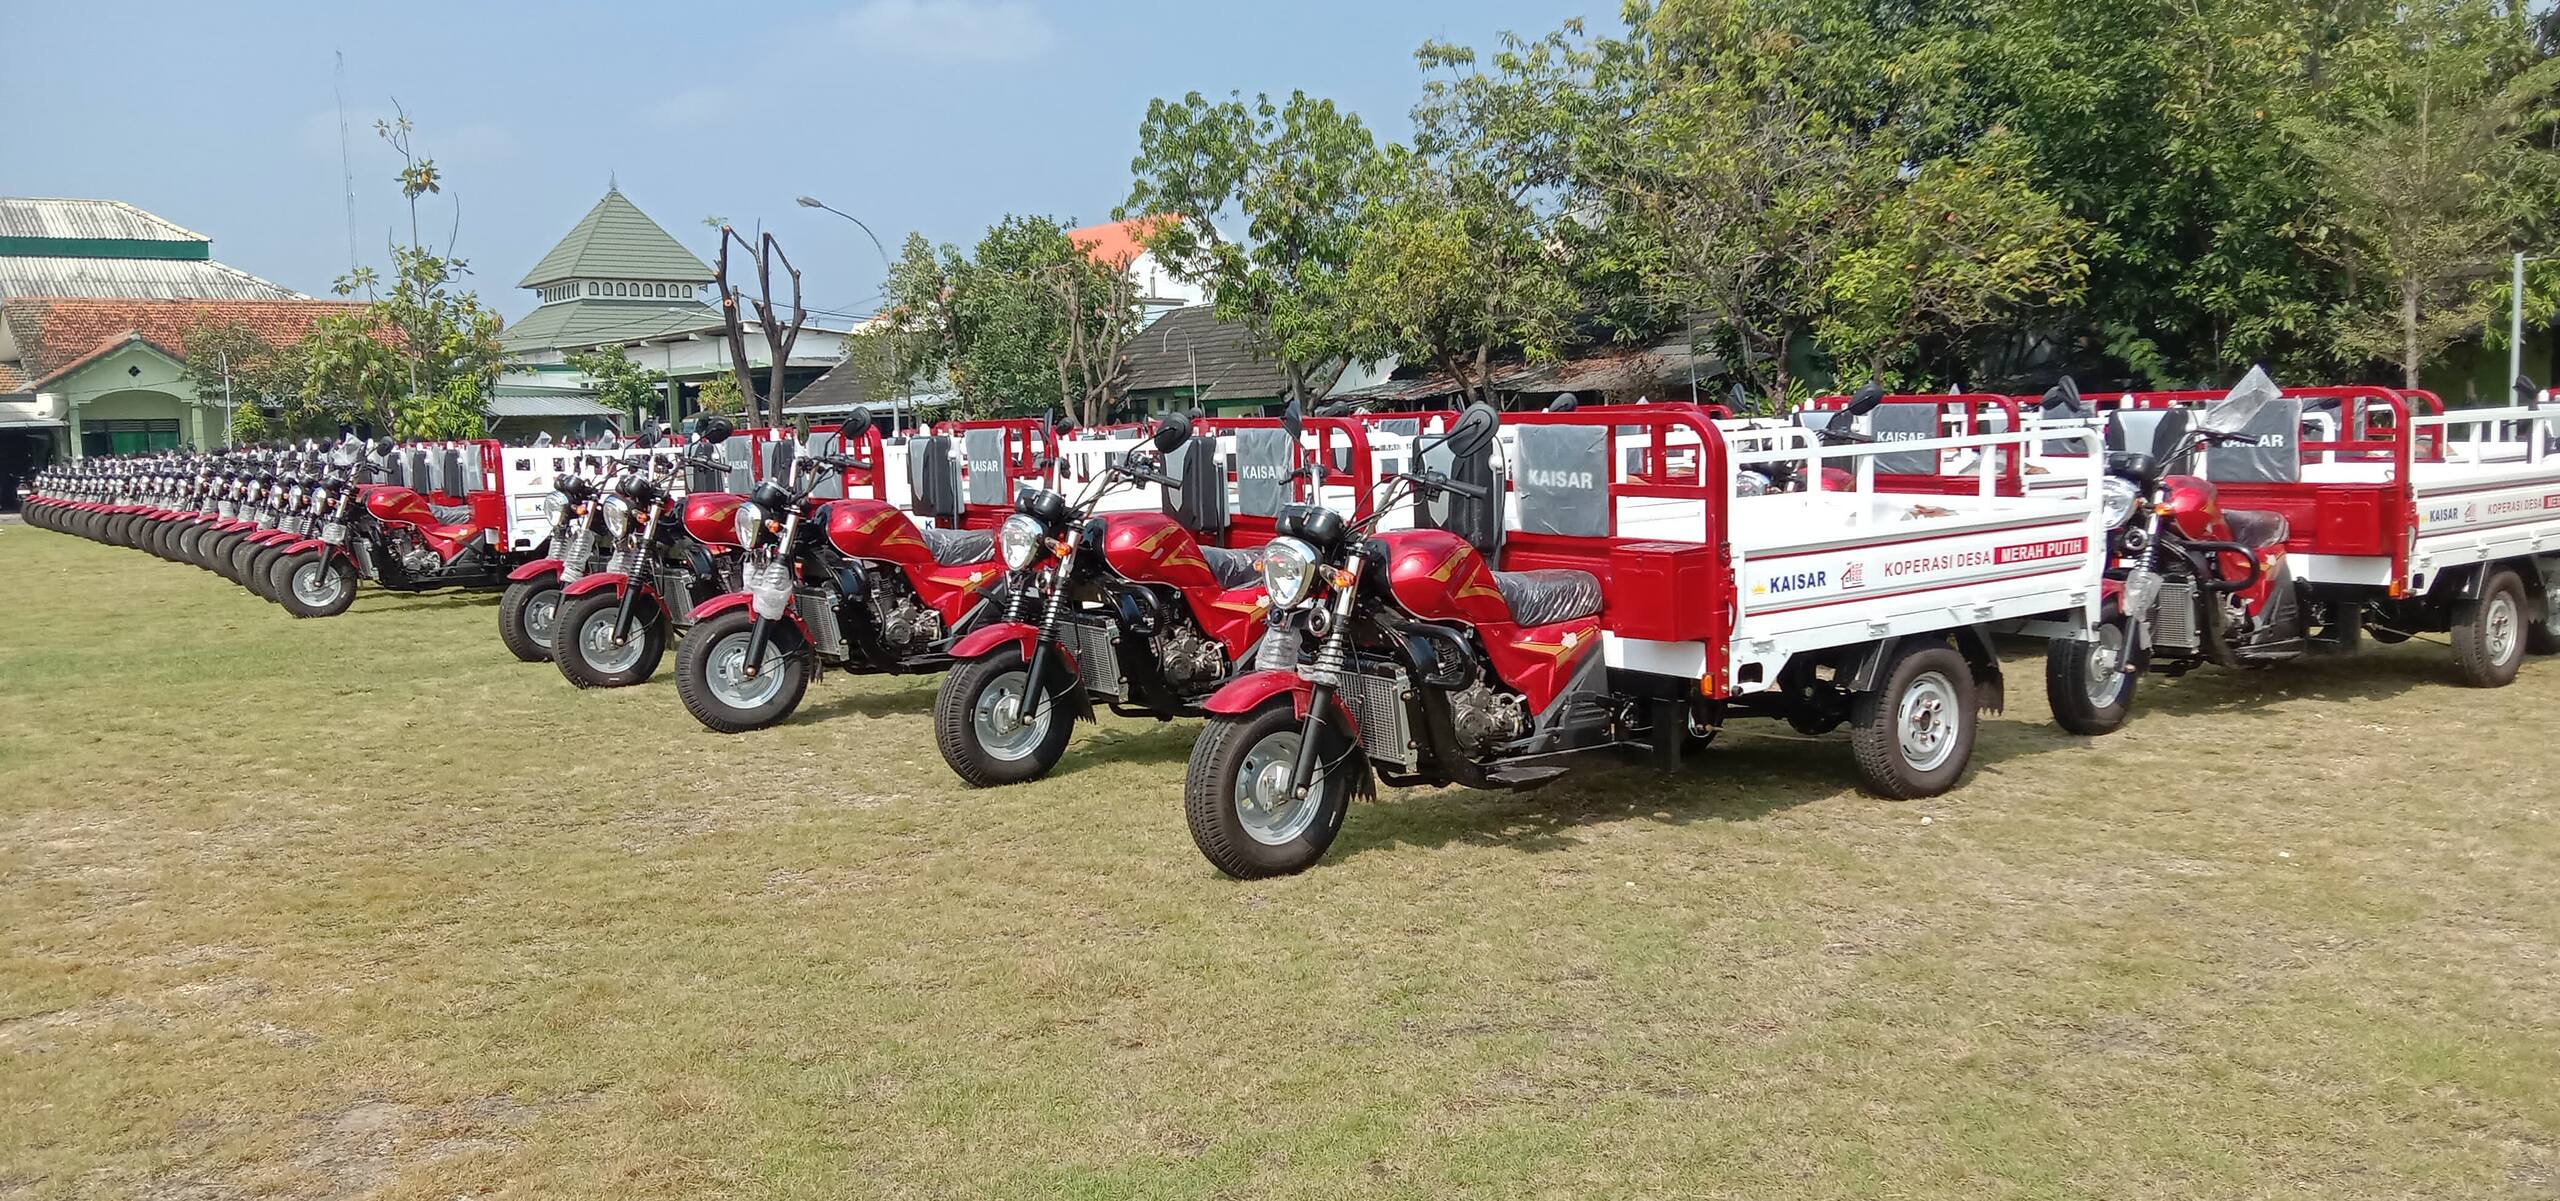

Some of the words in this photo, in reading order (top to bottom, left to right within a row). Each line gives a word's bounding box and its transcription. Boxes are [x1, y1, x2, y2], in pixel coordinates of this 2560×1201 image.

[971, 459, 999, 472] KAISAR
[1242, 464, 1279, 480] KAISA
[1527, 468, 1593, 489] KAISAR
[2429, 507, 2459, 522] KAISAR
[2487, 500, 2523, 515] KOPERASI
[2524, 498, 2543, 511] DESA
[1770, 571, 1827, 593] KAISAR
[1884, 554, 1954, 577] KOPERASI
[1957, 550, 1991, 567] DESA
[2001, 543, 2044, 563] MERAH
[2047, 539, 2082, 556] PUTIH
